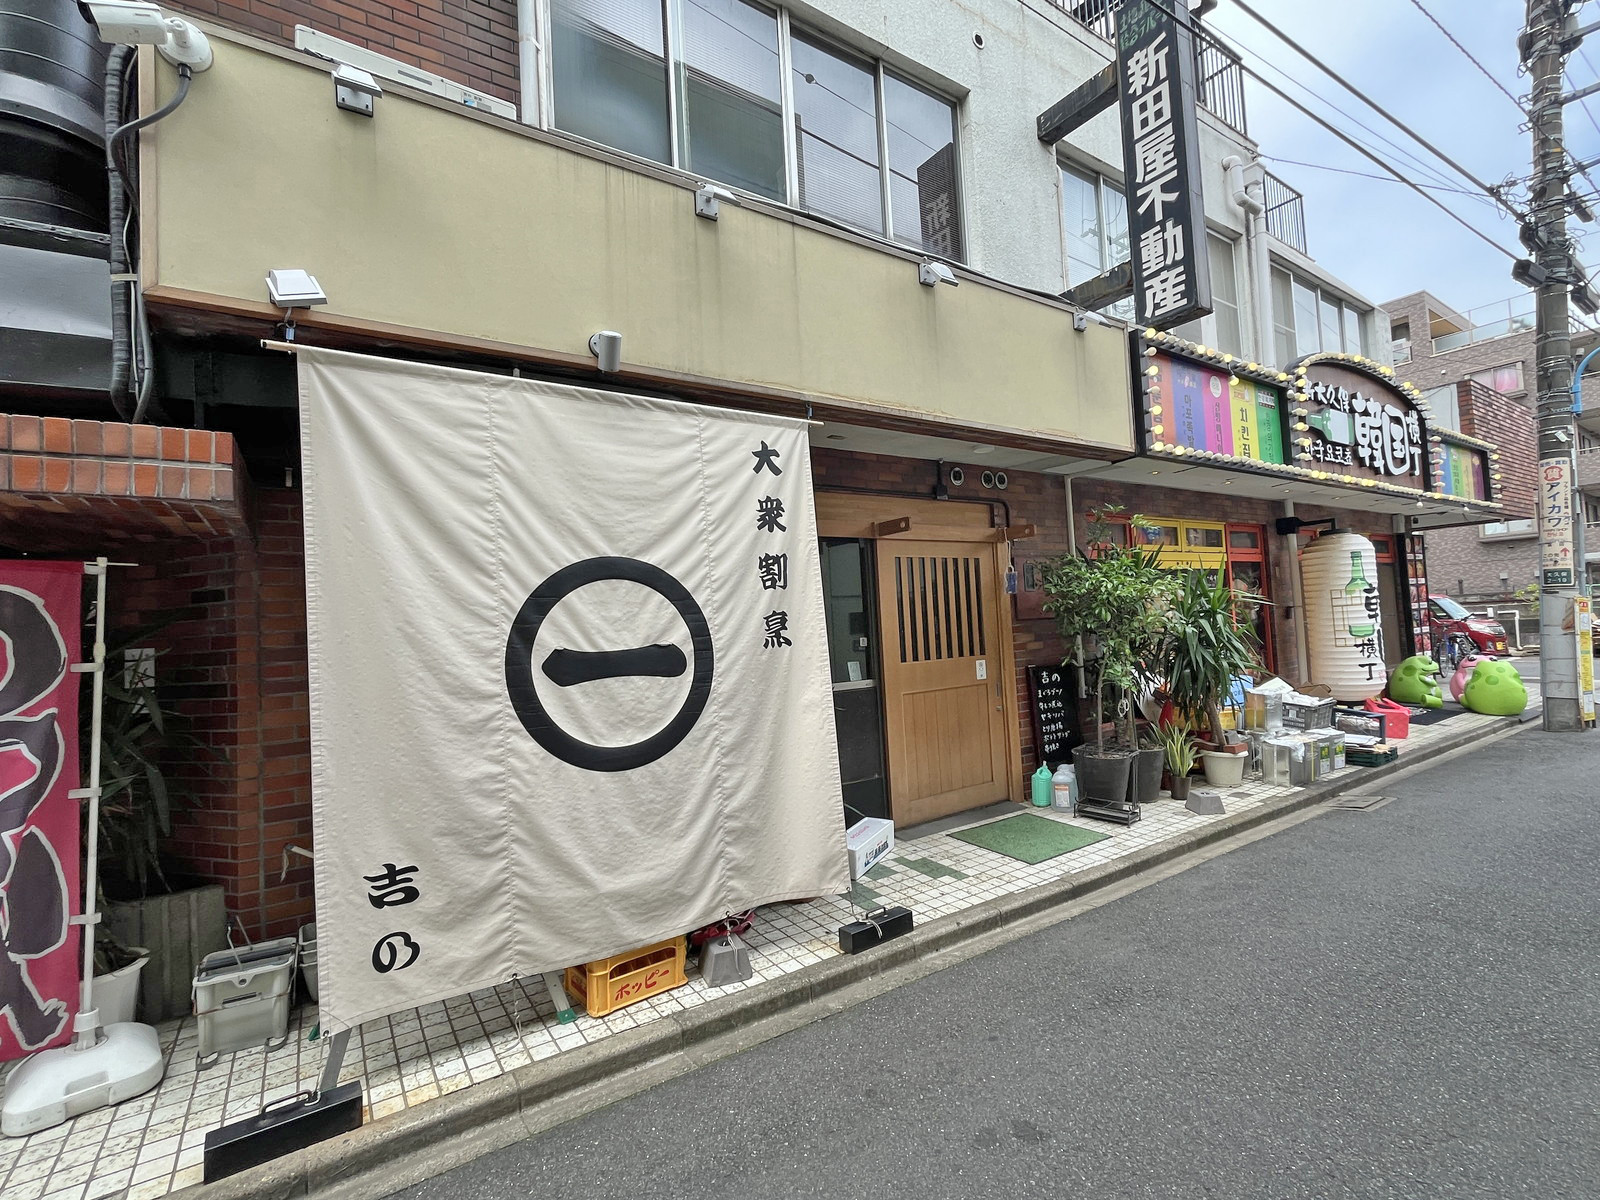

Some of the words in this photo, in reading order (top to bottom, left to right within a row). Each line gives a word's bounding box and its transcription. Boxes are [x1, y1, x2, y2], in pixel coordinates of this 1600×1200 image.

[1127, 31, 1188, 320] 新田屋不動産
[1546, 481, 1562, 528] アイカワ
[751, 440, 792, 650] 大衆割烹
[1041, 671, 1061, 684] 吉の
[362, 862, 421, 974] 吉の
[614, 968, 671, 1001] ホッピー
